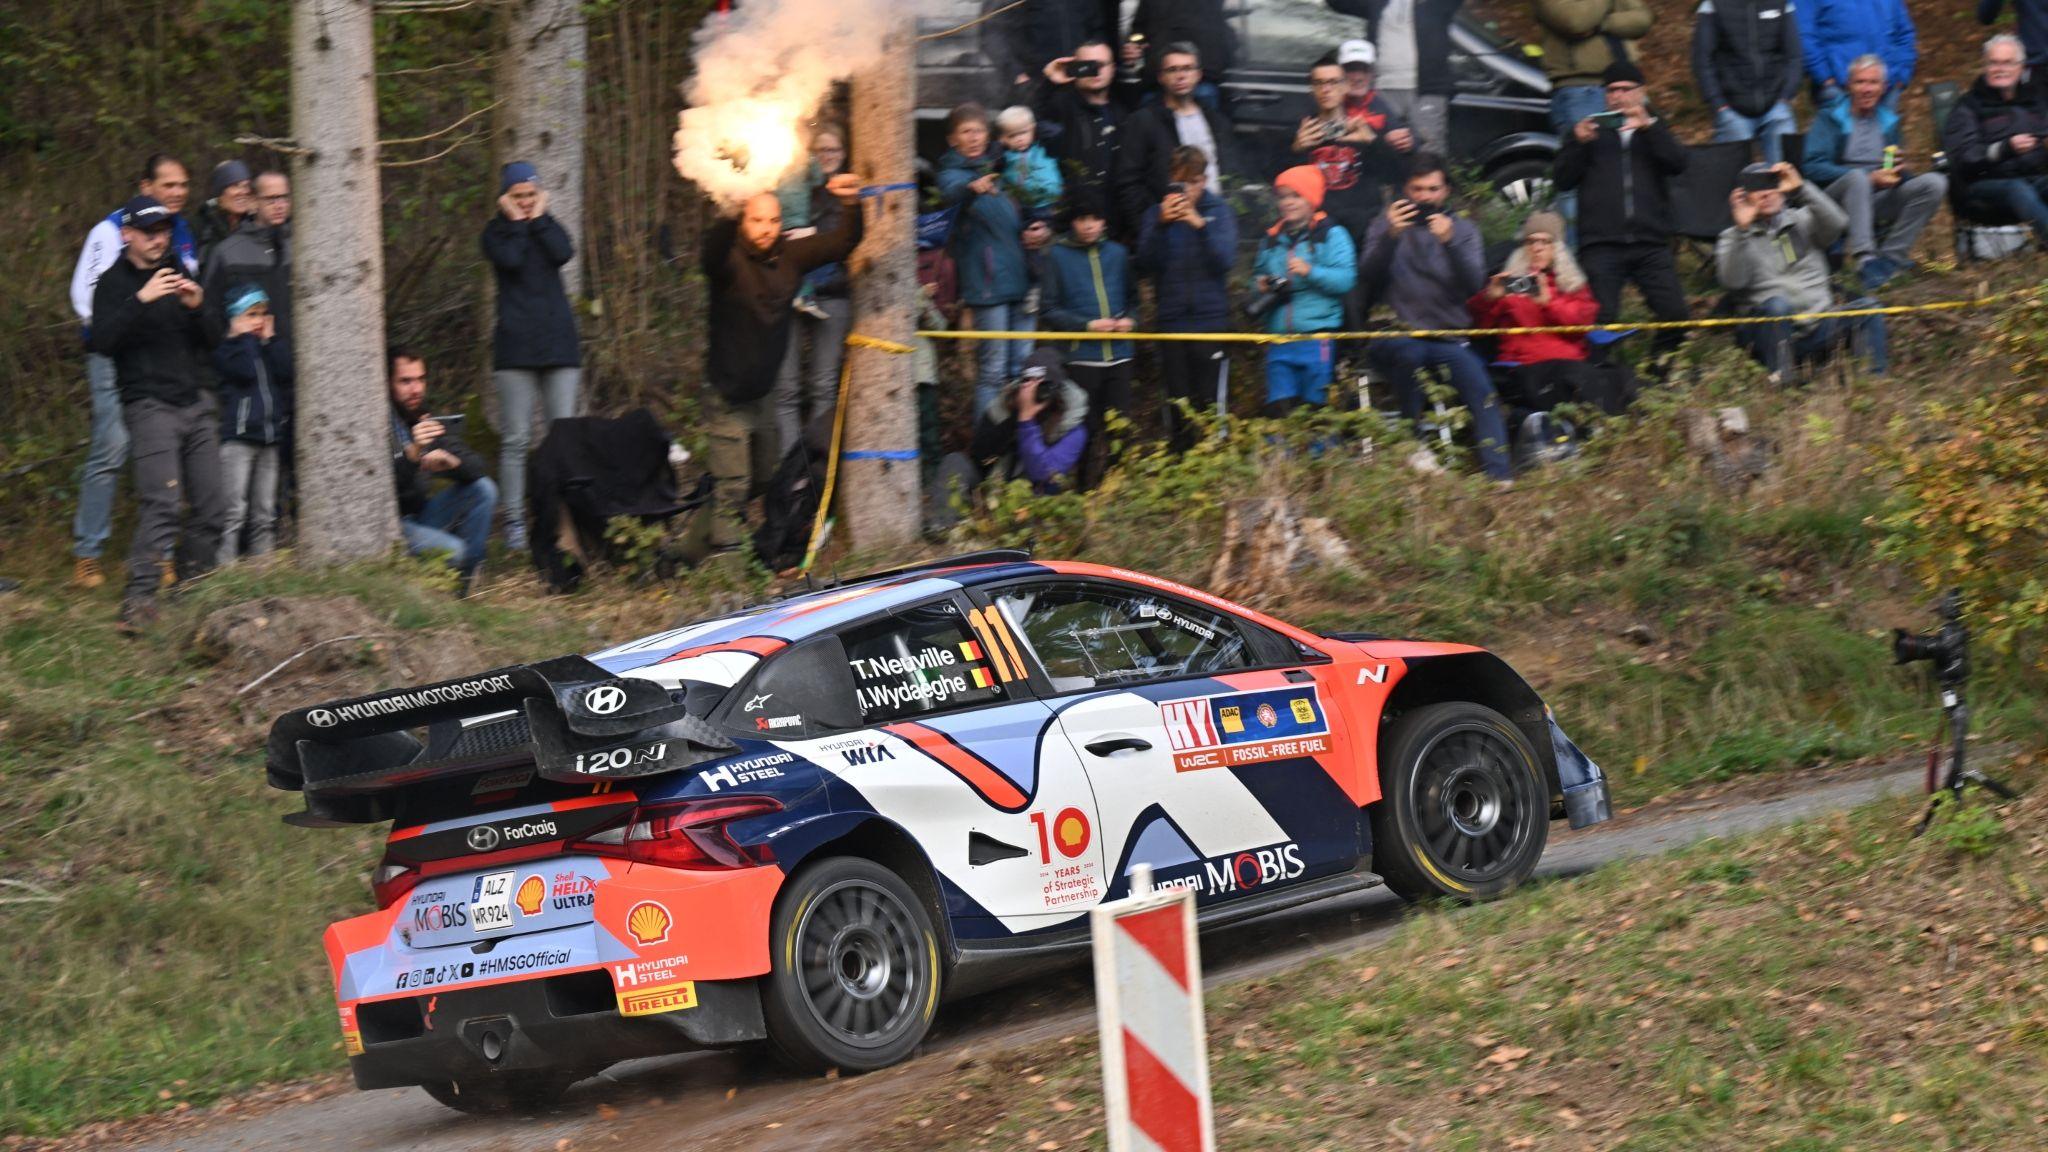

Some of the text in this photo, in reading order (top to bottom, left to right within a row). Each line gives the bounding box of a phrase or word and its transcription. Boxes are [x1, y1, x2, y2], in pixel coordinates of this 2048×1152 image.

[1173, 615, 1215, 640] HYUNDAI
[968, 604, 1029, 683] 11
[849, 646, 956, 680] T.Neuville
[336, 674, 515, 722] HYUNDAI MOTORSPORT
[1221, 708, 1239, 718] ADAC
[1162, 699, 1211, 750] HY
[819, 739, 865, 752] HYUNDAI
[841, 742, 897, 766] WIA
[1232, 739, 1327, 762] FOSSIL-FREE FUEL
[729, 753, 794, 773] HYUNDAI
[1181, 753, 1219, 768] WRC
[737, 767, 785, 784] STEEL
[503, 819, 557, 841] ForCraig
[1030, 807, 1091, 865] 10
[555, 871, 575, 882] Shell
[1054, 865, 1081, 879] YEARS
[1128, 843, 1306, 897] UNDAI MOBIS
[483, 878, 506, 897] ALZ
[553, 876, 599, 897] HELIX
[1044, 874, 1095, 894] of Strategic
[411, 891, 447, 905] HYUNDAI
[1044, 886, 1099, 906] Partnership
[415, 902, 467, 932] MOBIS
[487, 904, 508, 923] 924
[479, 949, 572, 975] #HMSGOfficial
[637, 955, 689, 972] HYUNDAI
[639, 969, 678, 984] STEEL
[622, 987, 690, 1013] PIRELLI
